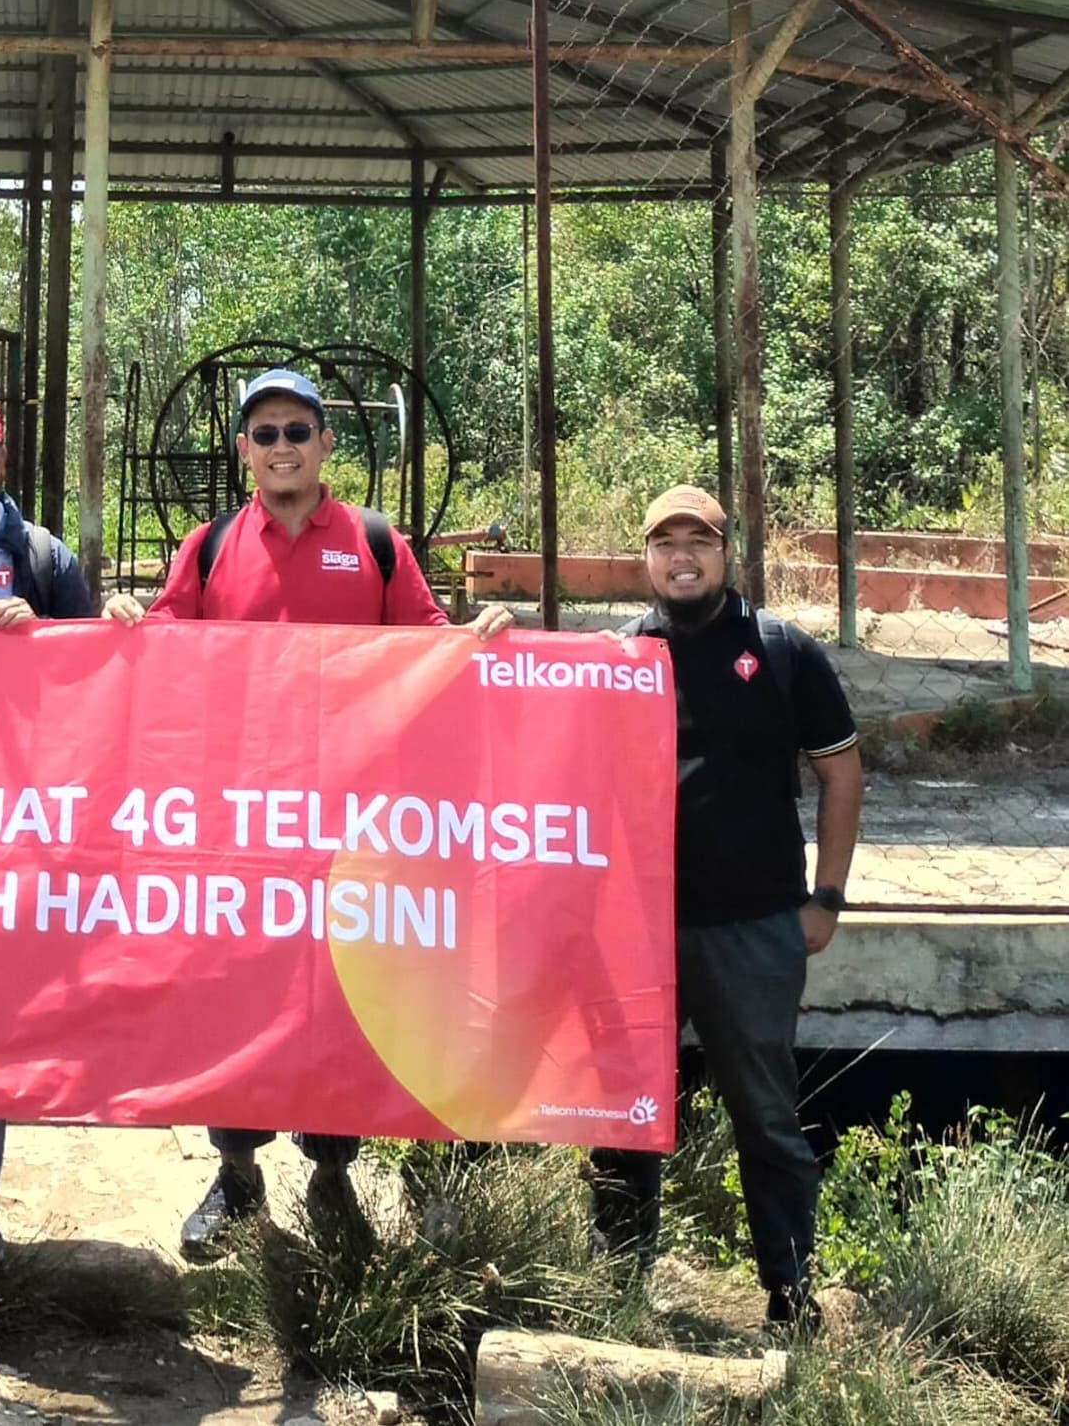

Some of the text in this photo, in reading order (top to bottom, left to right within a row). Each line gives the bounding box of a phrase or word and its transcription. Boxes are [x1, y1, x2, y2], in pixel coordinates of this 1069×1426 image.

[471, 652, 665, 695] Telkomsel
[111, 787, 197, 846] 4G
[222, 789, 609, 867] TELKOMSEL
[35, 871, 247, 937] HADIR
[261, 877, 457, 950] DISINI
